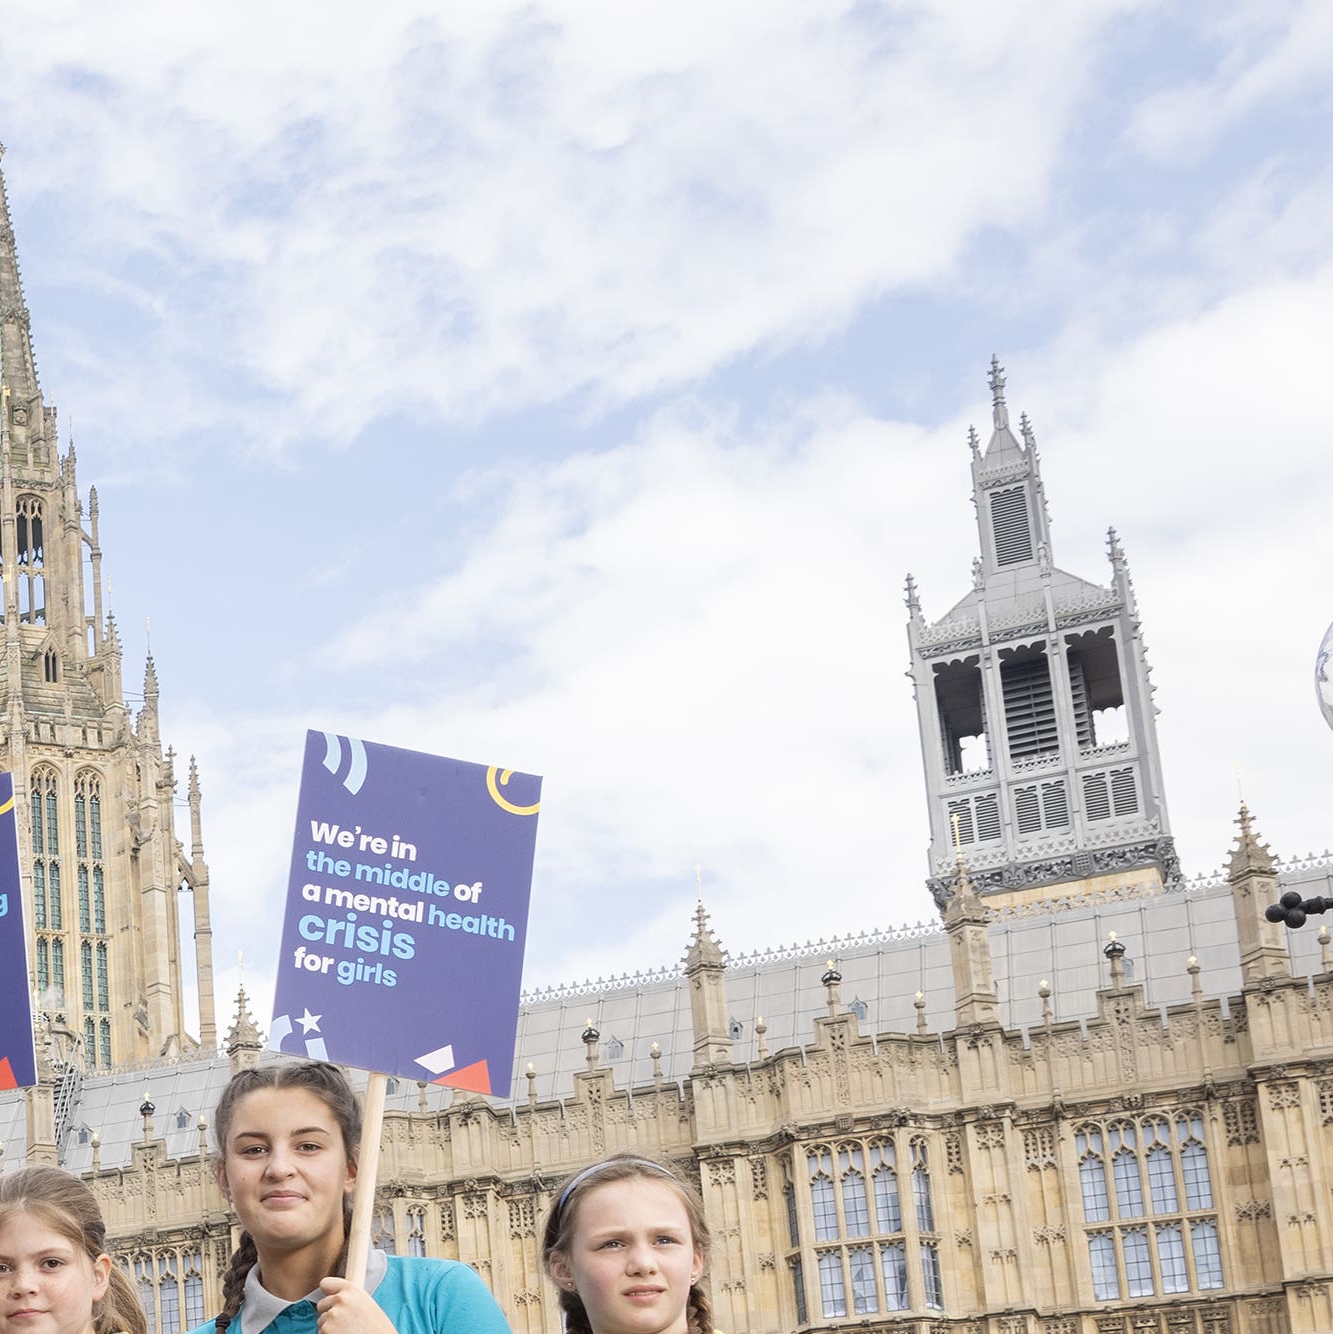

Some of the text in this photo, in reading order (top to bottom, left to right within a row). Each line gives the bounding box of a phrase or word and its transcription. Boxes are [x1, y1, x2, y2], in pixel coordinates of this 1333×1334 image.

[310, 820, 417, 861] We're in
[305, 850, 482, 903] the middle of
[298, 911, 415, 960] crisis
[302, 882, 515, 941] a mental health
[293, 946, 397, 987] for girls
